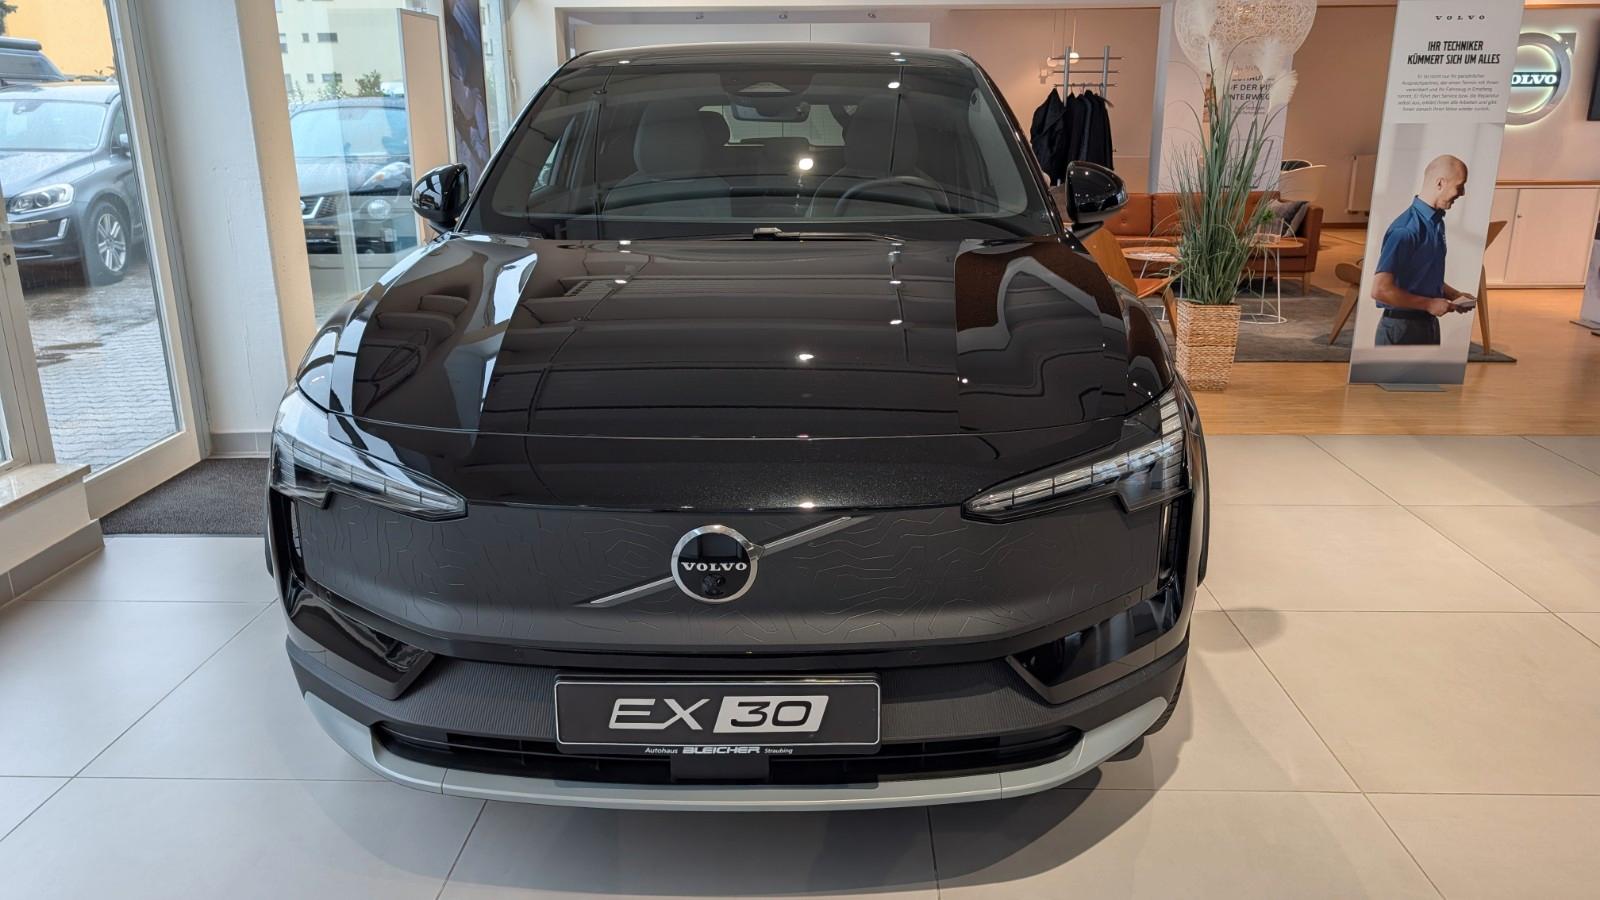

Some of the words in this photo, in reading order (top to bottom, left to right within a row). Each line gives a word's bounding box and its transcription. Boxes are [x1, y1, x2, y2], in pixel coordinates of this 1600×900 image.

[1427, 40, 1441, 51] IHR
[1443, 40, 1484, 51] TECHNIKER
[1407, 52, 1445, 65] KÜMMERT
[1445, 54, 1462, 65] SICH
[1464, 54, 1477, 65] UM
[1478, 53, 1501, 64] ALLES
[1511, 74, 1558, 85] OLVO
[1240, 83, 1258, 91] DER
[681, 562, 748, 572] VOLVO
[608, 698, 711, 730] EX
[730, 700, 813, 728] 30
[645, 746, 678, 754] Autohaus
[682, 746, 761, 754] BLEICHER
[764, 747, 794, 755] Straubing
